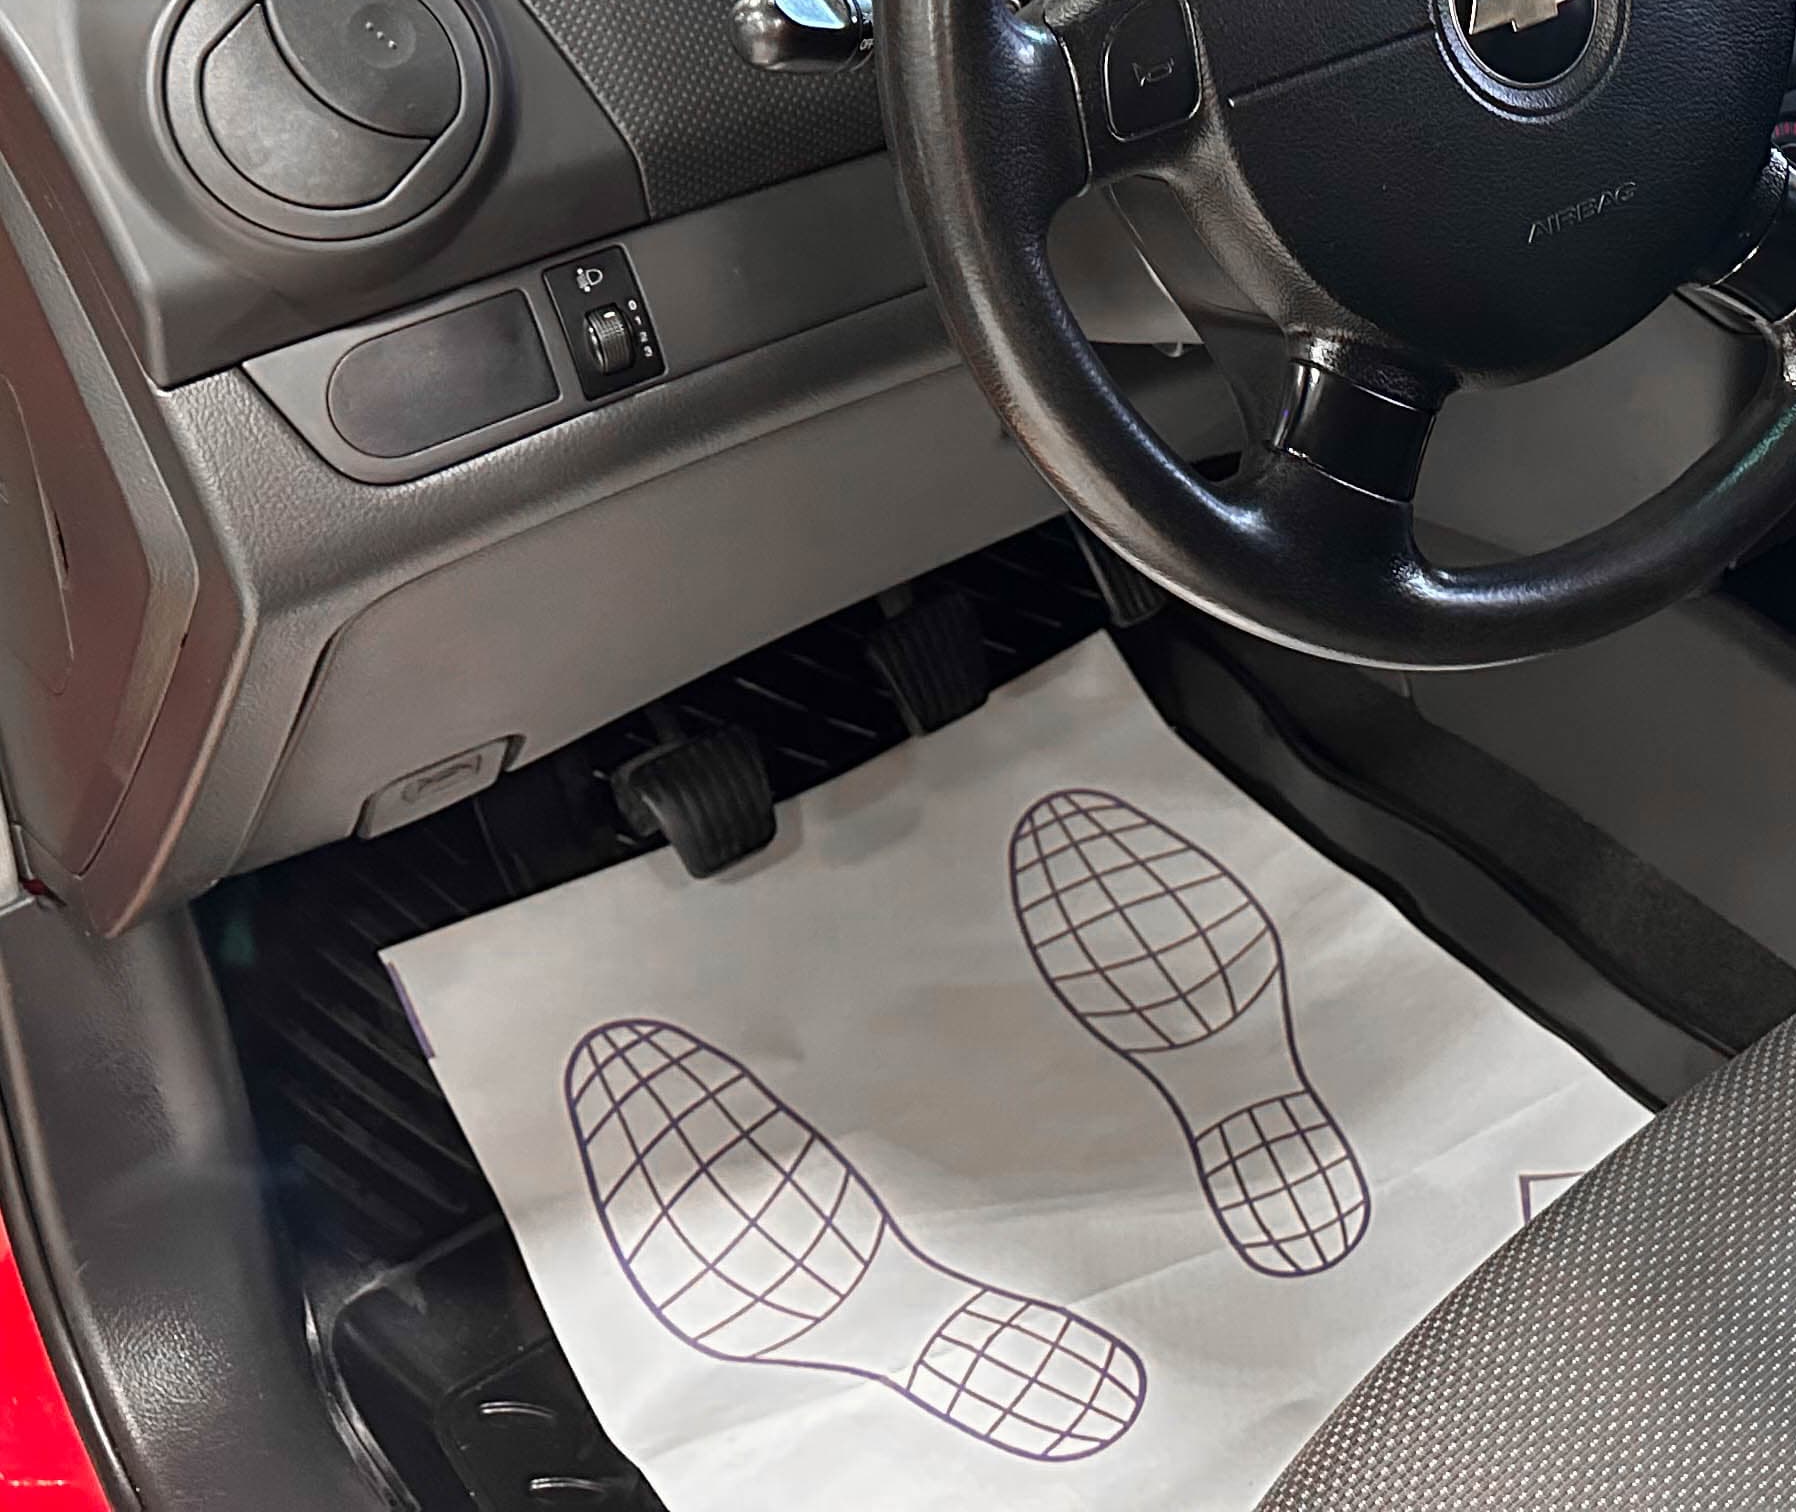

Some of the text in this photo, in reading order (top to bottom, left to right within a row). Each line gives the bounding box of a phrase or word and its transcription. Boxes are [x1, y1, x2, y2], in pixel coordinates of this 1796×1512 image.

[1528, 182, 1636, 243] AIRBAG
[628, 299, 637, 310] 0
[644, 345, 652, 357] 3
